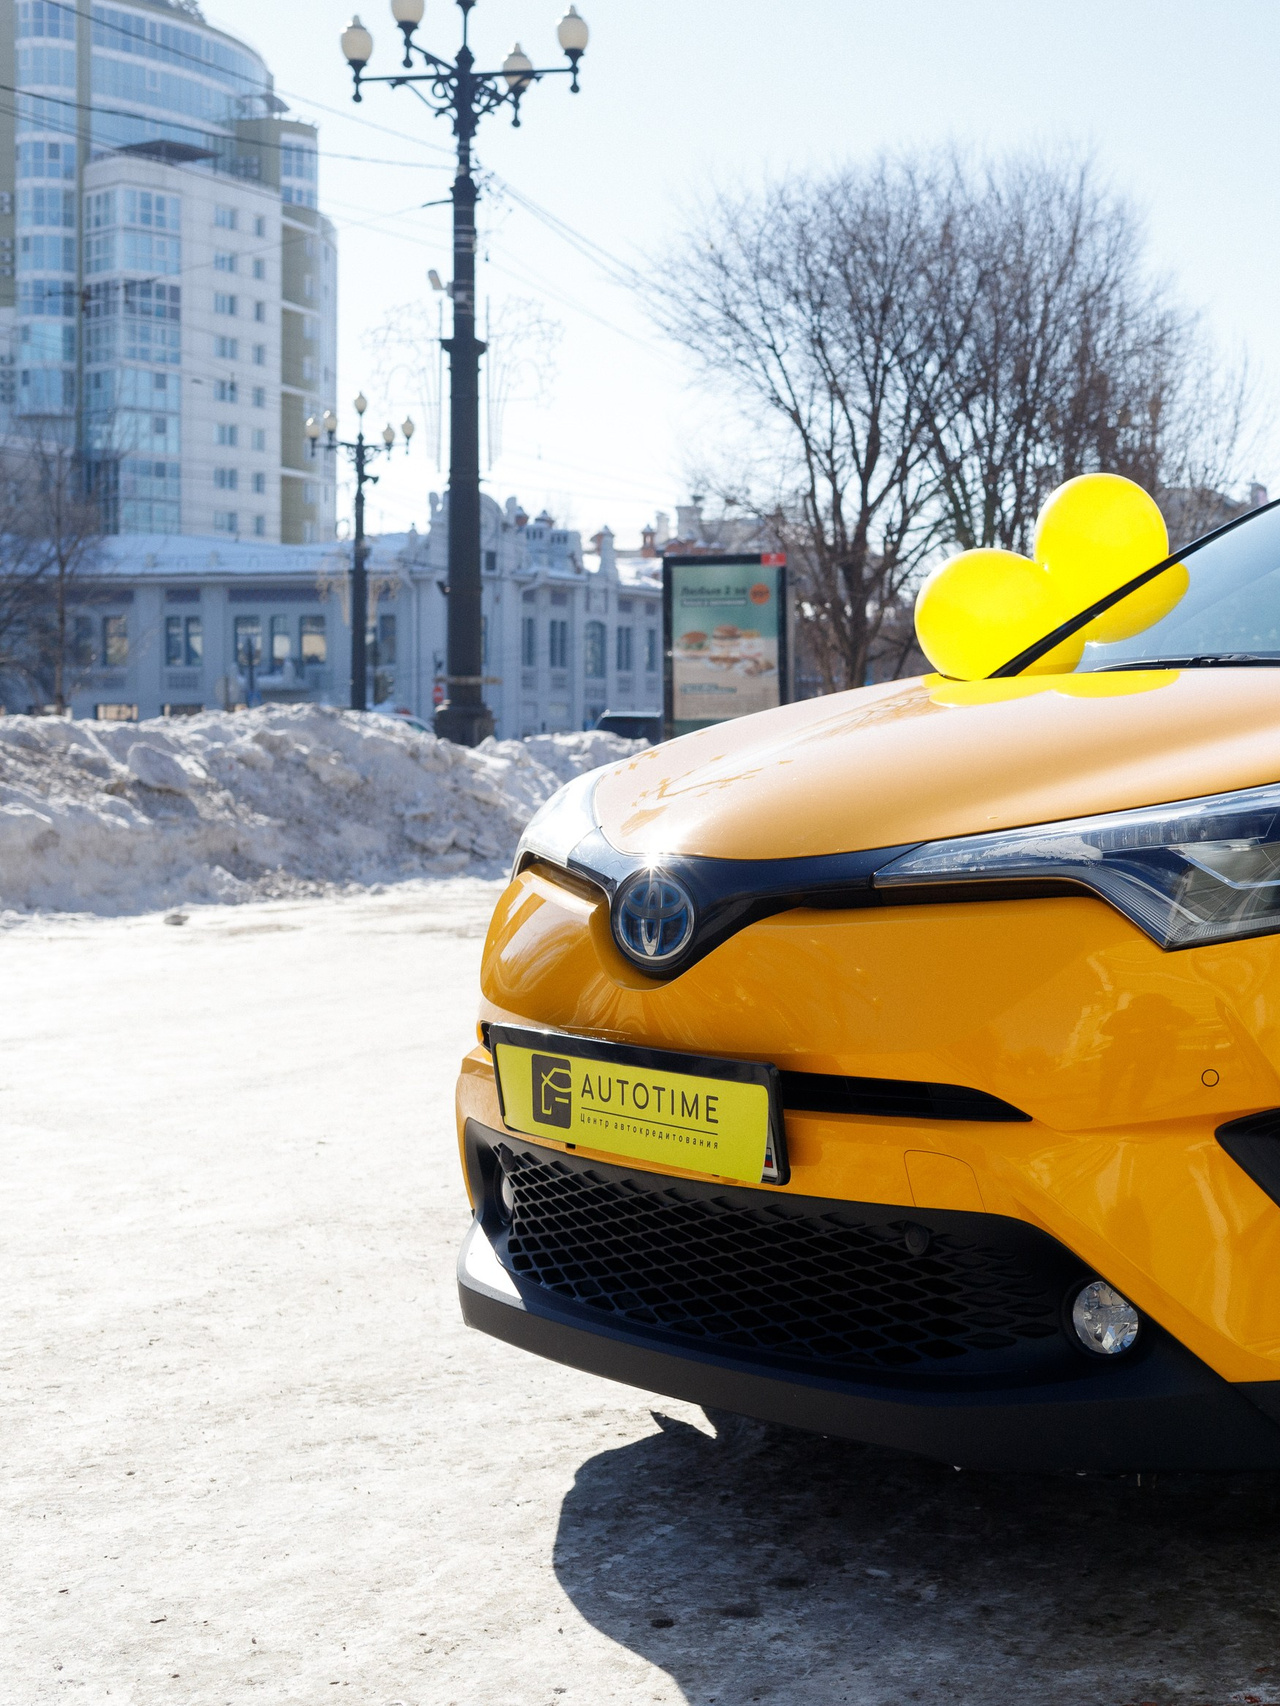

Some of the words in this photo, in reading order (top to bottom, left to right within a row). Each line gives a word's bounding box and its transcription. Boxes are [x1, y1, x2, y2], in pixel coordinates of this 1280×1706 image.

[581, 1073, 719, 1124] AUTOTIME
[580, 1113, 609, 1130] Центр
[614, 1121, 719, 1149] автокредитования
